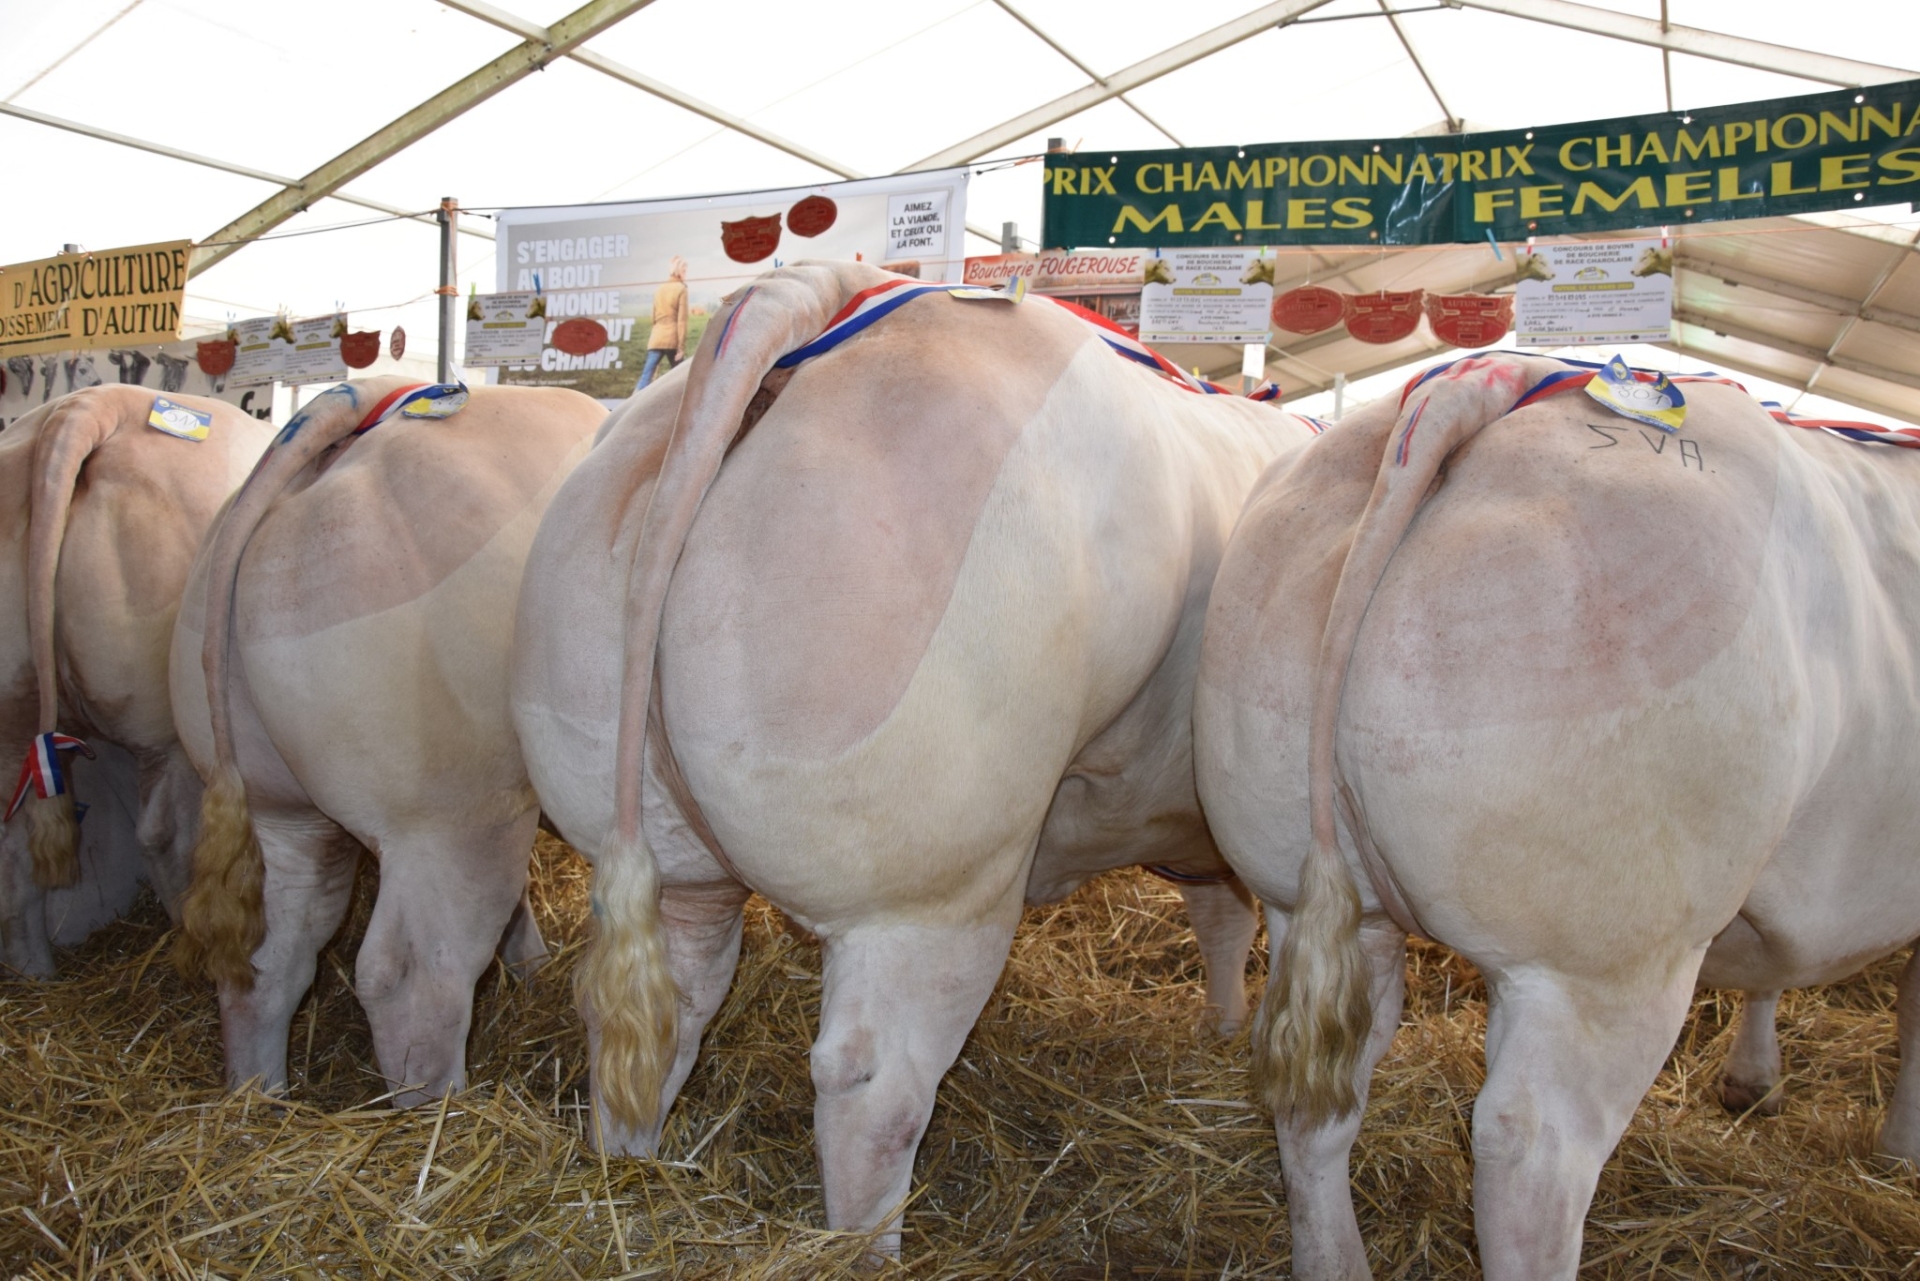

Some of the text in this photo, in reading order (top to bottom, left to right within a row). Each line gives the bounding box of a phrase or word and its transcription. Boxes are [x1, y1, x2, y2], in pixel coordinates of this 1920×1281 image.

[1135, 152, 1453, 194] CHAMPIONNAT
[1474, 147, 1920, 223] FEMELLES
[893, 212, 940, 226] LA VIANDE,
[904, 201, 932, 213] AIMEZ
[1111, 197, 1374, 234] MALES
[891, 224, 942, 239] ET CEUX QUI
[897, 237, 934, 249] LA FONT.
[517, 234, 630, 265] S'ENGAGER
[1587, 256, 1633, 264] CHAROLAISE
[517, 264, 602, 292] AU BOUT
[968, 256, 1140, 280] Boucherie FOUGEROUSE
[546, 291, 620, 317] MONDE
[1447, 300, 1477, 308] AUTUN
[0, 301, 181, 338] ISSEMENT D'AUTUN
[541, 347, 623, 373] CHAMP.
